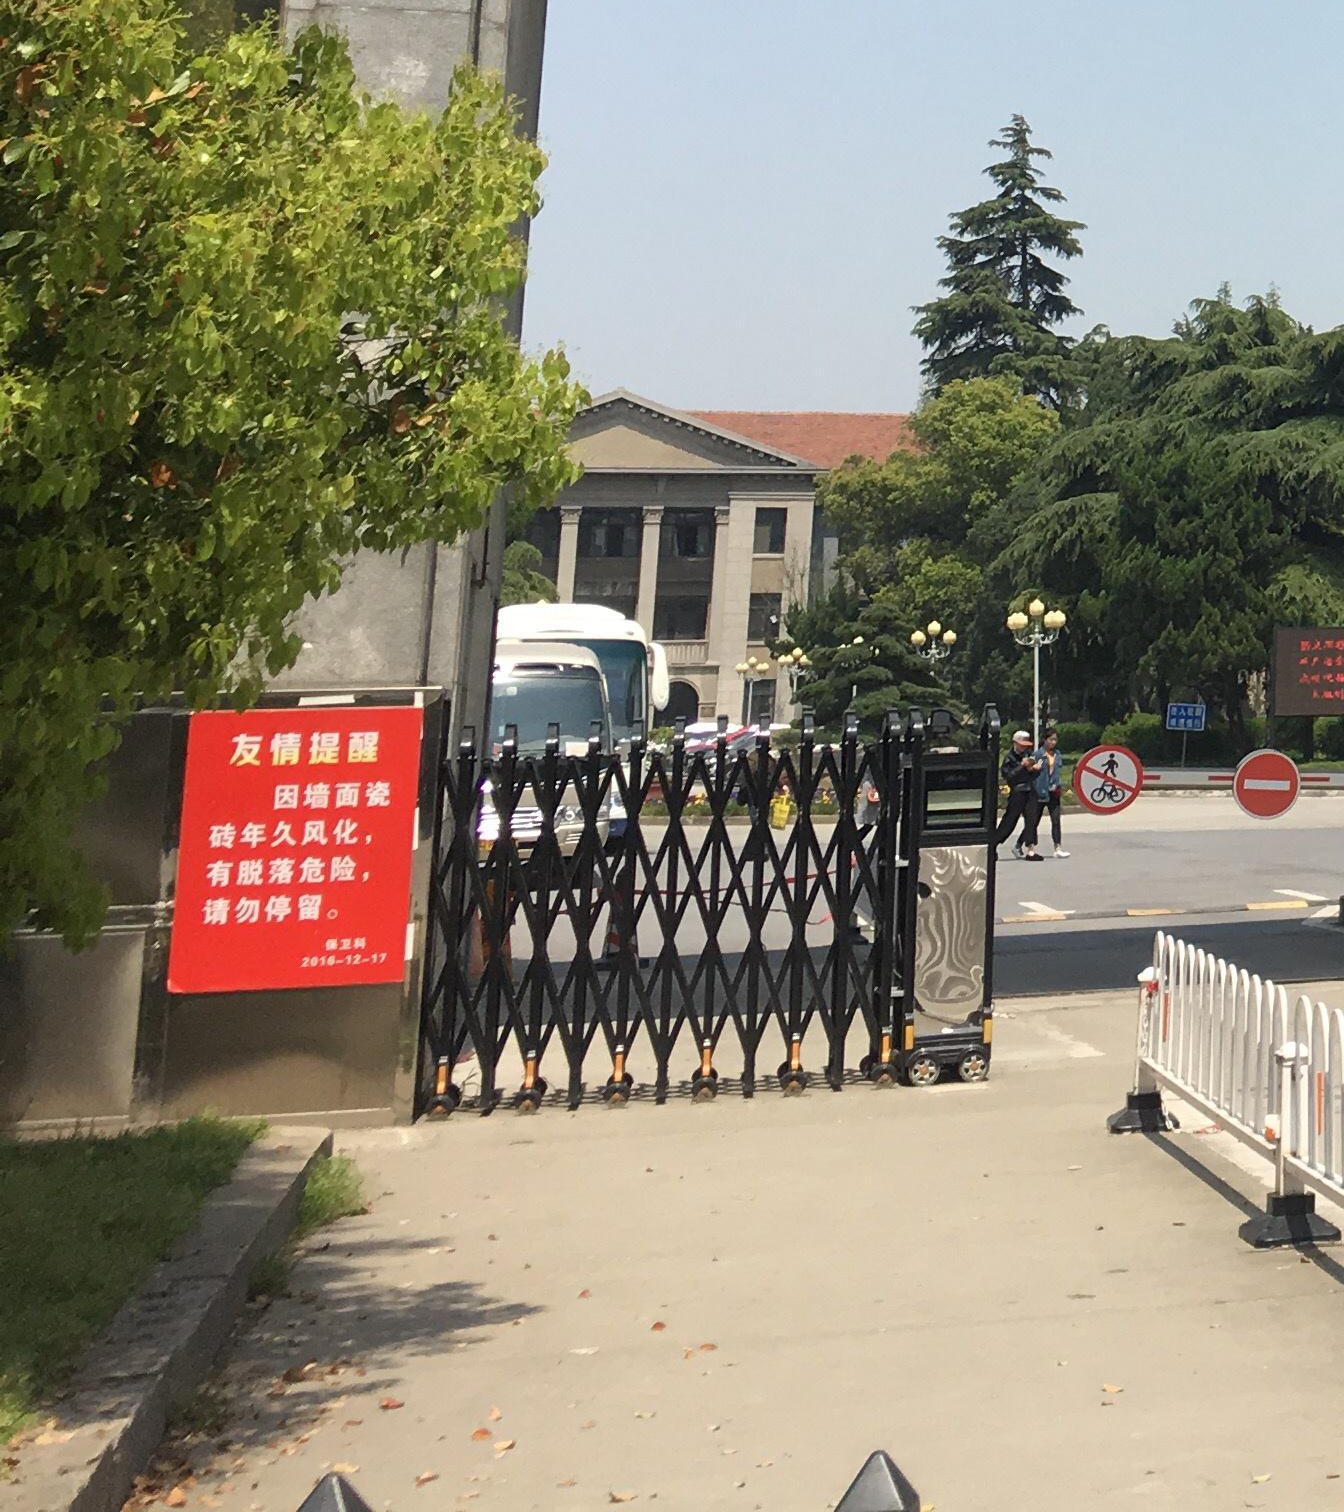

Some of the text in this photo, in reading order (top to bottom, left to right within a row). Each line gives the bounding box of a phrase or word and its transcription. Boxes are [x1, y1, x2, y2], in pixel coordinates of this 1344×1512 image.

[229, 731, 380, 768] 友情提醒
[273, 780, 391, 810] 因墙面瓷
[208, 818, 373, 849] 砖年久风化，
[205, 855, 370, 888] 有脱落危险，
[202, 893, 339, 926] 请勿停留。
[324, 936, 367, 951] 保卫科
[299, 952, 388, 969] 2016-12-17
